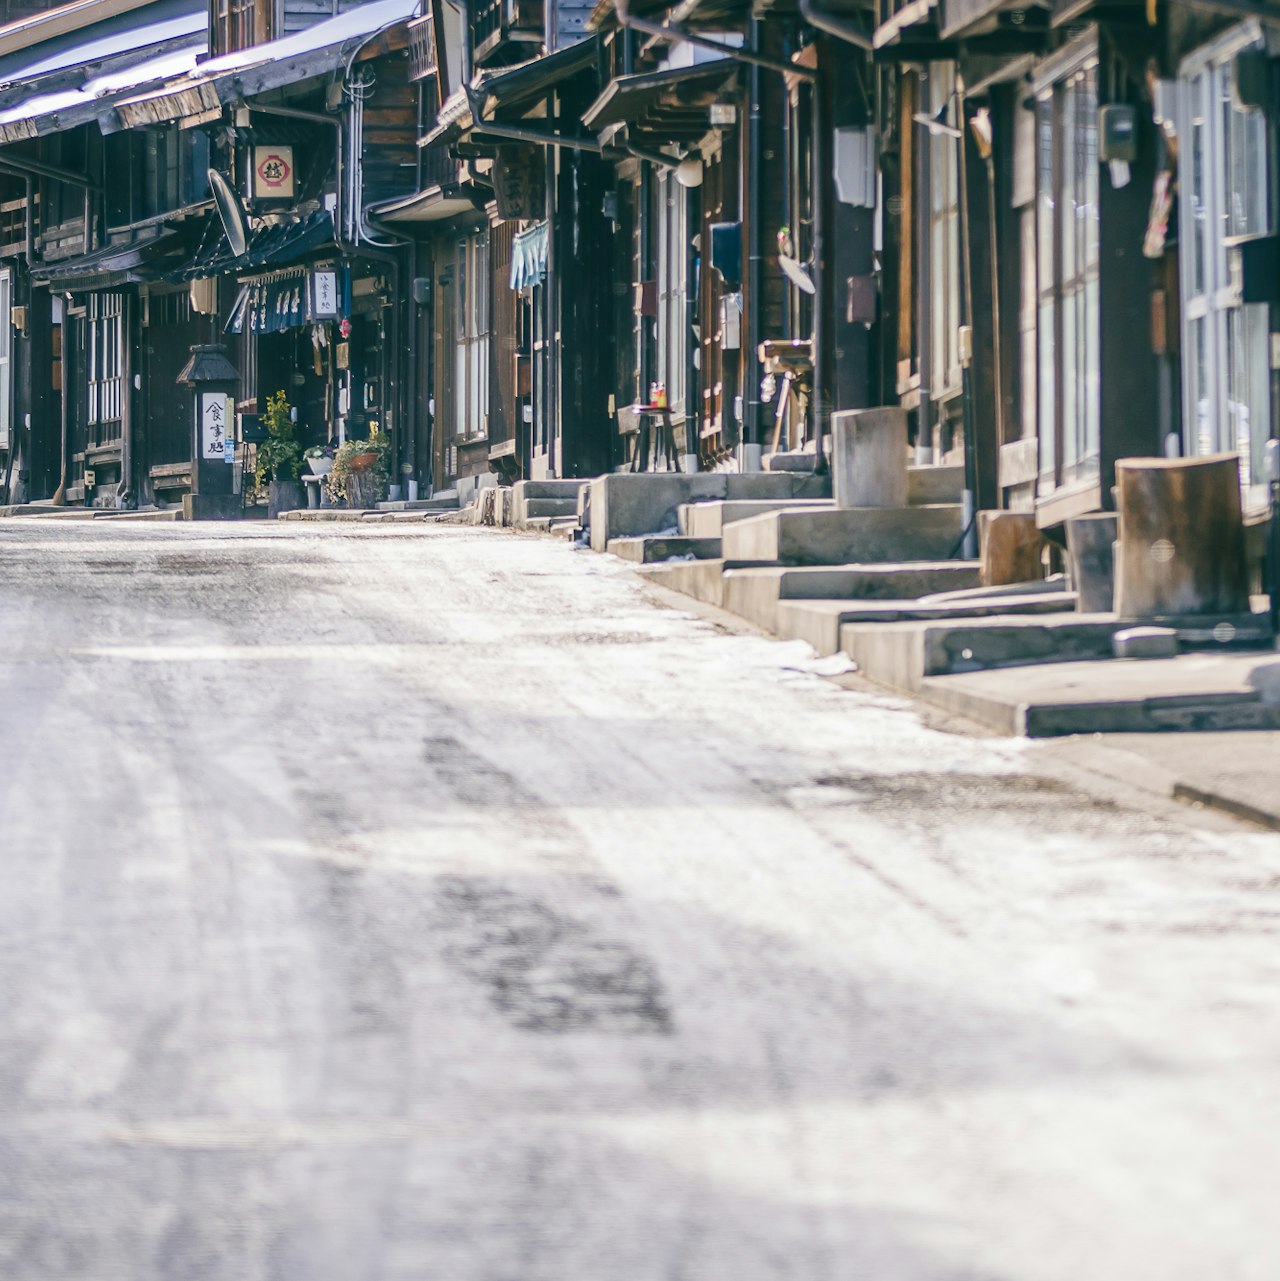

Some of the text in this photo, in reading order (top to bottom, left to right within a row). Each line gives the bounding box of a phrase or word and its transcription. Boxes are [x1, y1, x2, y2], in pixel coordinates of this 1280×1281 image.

[264, 162, 282, 179] 越
[206, 402, 224, 454] 食事処
